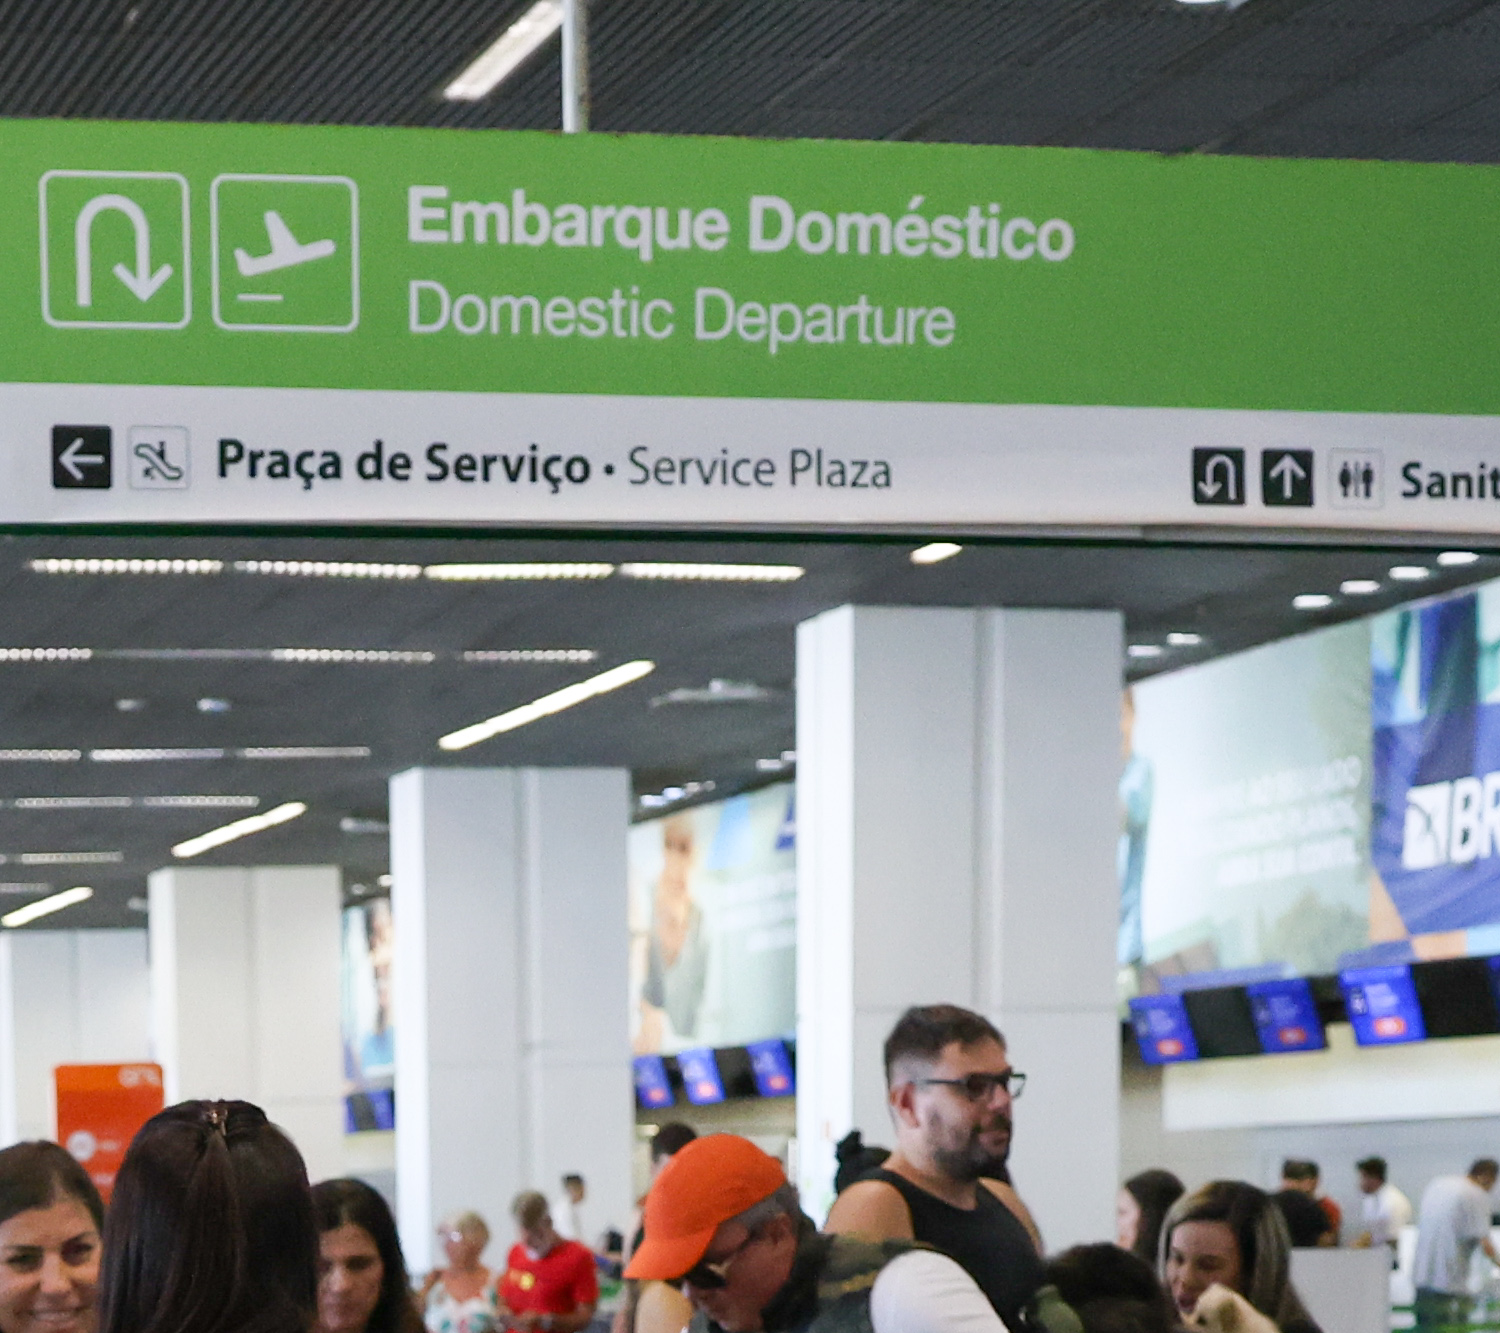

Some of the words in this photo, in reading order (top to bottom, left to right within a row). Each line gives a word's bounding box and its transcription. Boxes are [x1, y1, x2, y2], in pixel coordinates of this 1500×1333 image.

[407, 186, 730, 260] Embarque
[749, 195, 1074, 262] Doméstico
[408, 280, 673, 341] Domestic
[695, 287, 956, 355] Departure
[217, 438, 345, 491] Praça
[358, 440, 412, 482] de
[426, 443, 590, 495] Serviço
[628, 446, 775, 488] Service
[788, 448, 892, 489] Plaza
